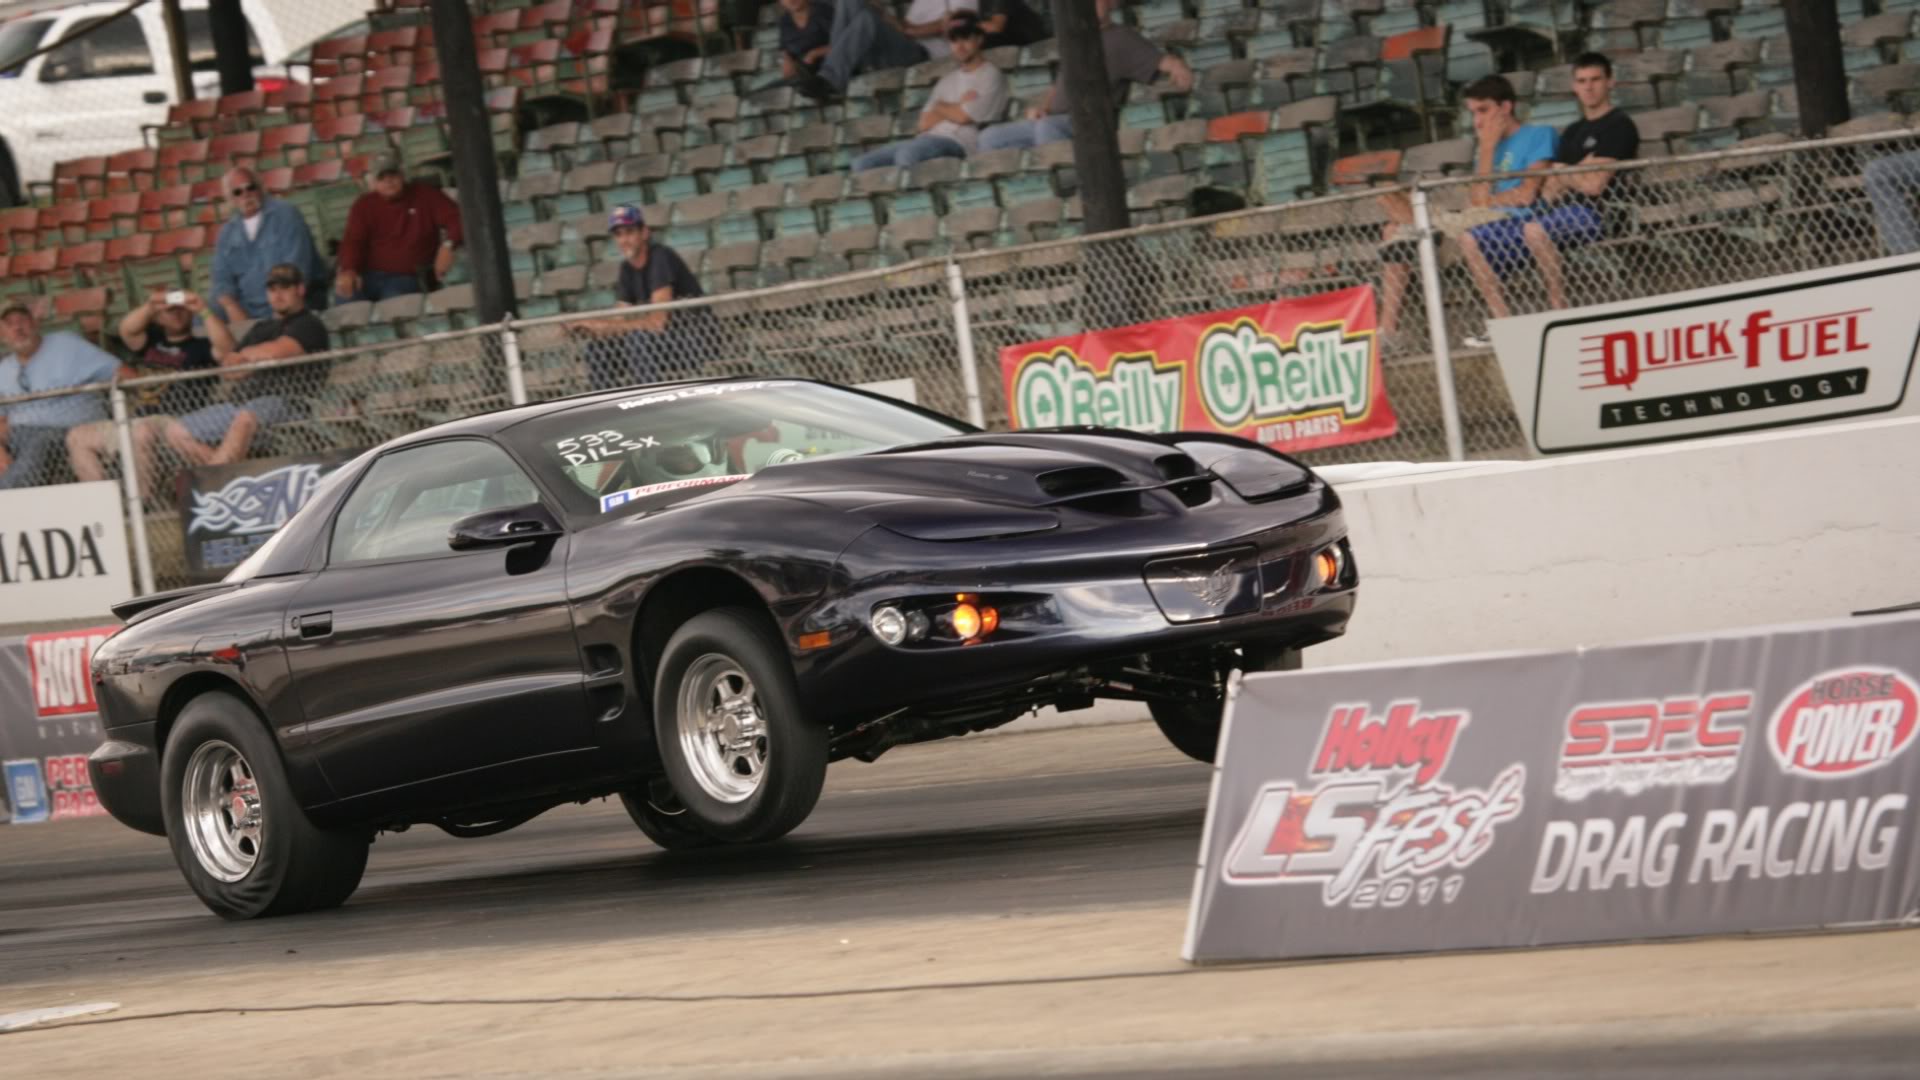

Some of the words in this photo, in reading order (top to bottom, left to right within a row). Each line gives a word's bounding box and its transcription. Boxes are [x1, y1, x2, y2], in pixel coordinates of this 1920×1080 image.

[1207, 331, 1366, 418] O'Reilly
[1603, 319, 1733, 390] QUICK
[1023, 362, 1177, 433] O'Reilly
[1257, 423, 1295, 444] AUTO
[1297, 414, 1341, 437] PARTS
[1611, 375, 1860, 423] TECHNOLOGY
[556, 430, 624, 455] 533
[31, 636, 88, 709] HOT
[1809, 672, 1895, 705] HORSE
[1310, 700, 1467, 789] Holley
[1783, 699, 1905, 769] POWER
[1530, 813, 1688, 893] DRAG
[1688, 794, 1908, 882] RACING
[1350, 876, 1463, 907] 2011
